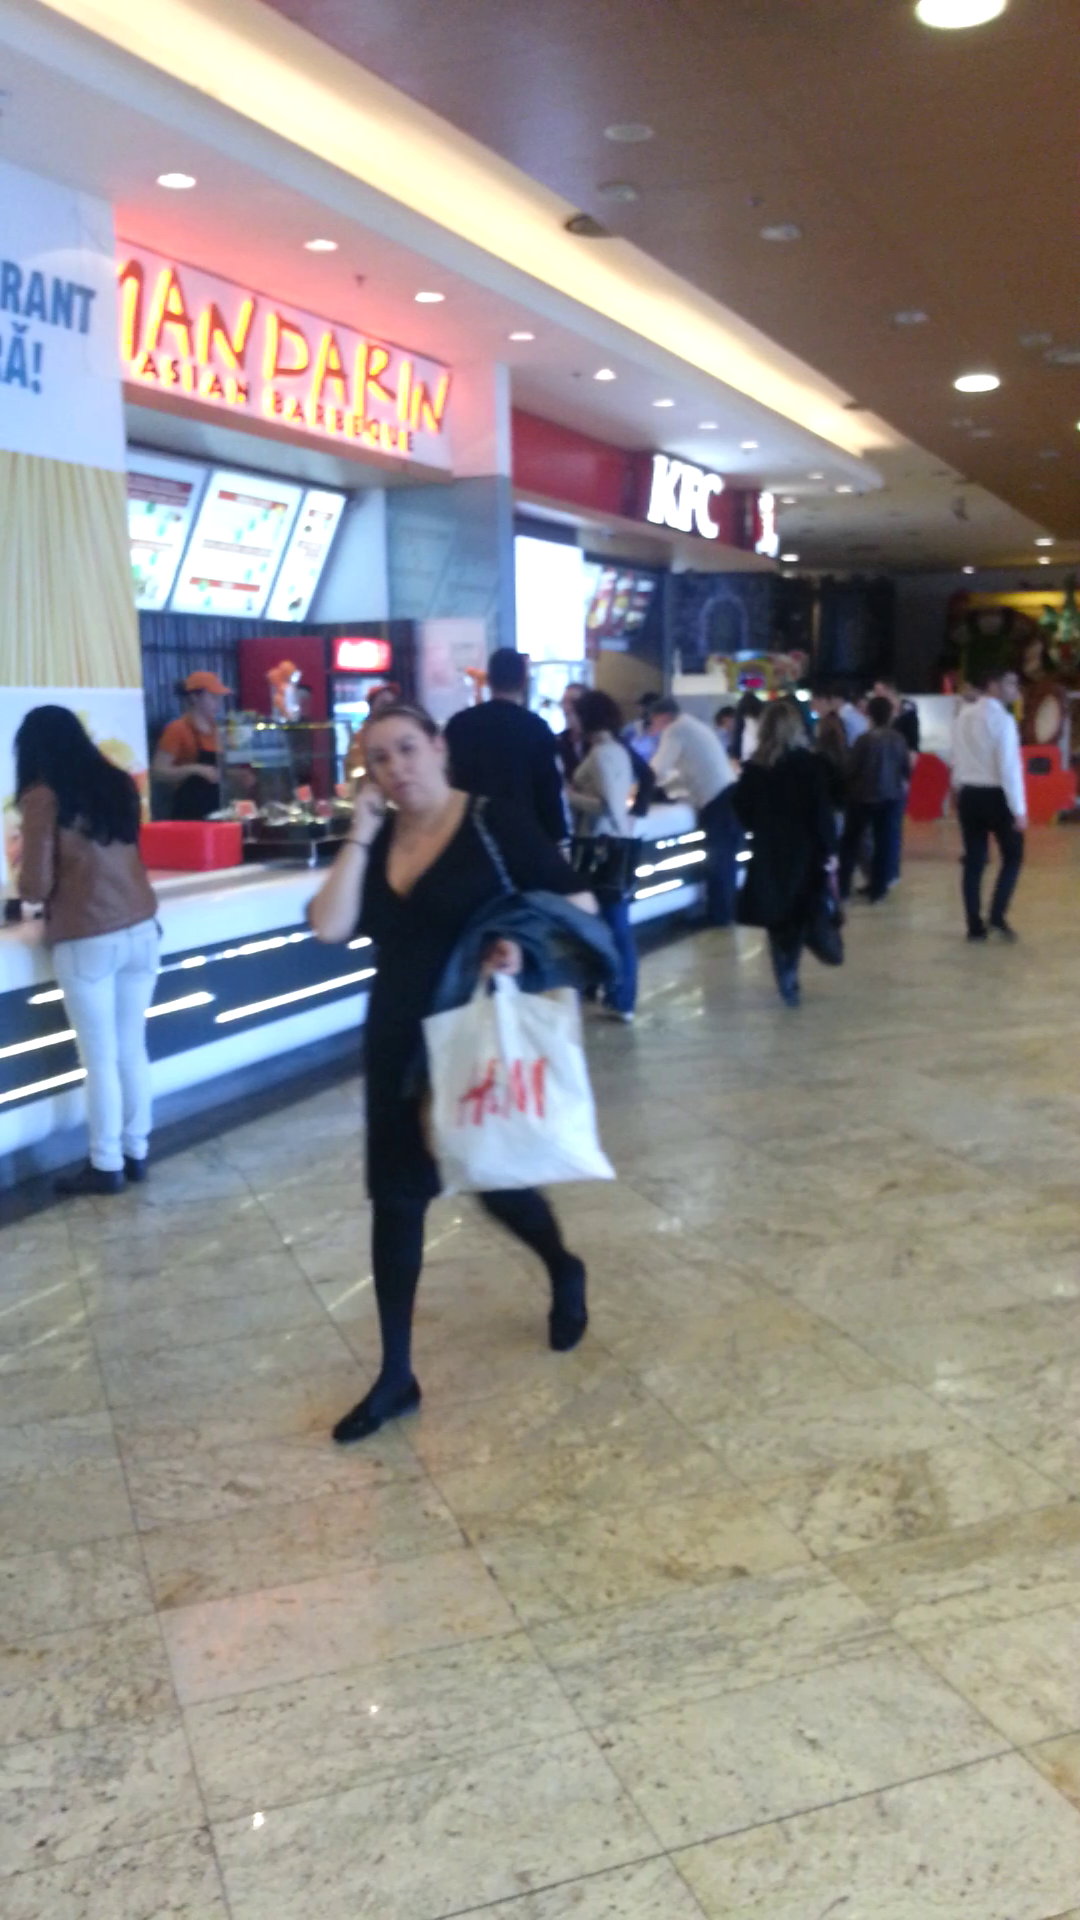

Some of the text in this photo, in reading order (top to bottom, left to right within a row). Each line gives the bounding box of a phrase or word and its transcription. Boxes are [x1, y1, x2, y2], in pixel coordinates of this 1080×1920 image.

[0, 260, 97, 335] RANT
[0, 320, 43, 396] Ă!
[130, 351, 250, 405] ASIAN
[647, 454, 725, 539] KFC
